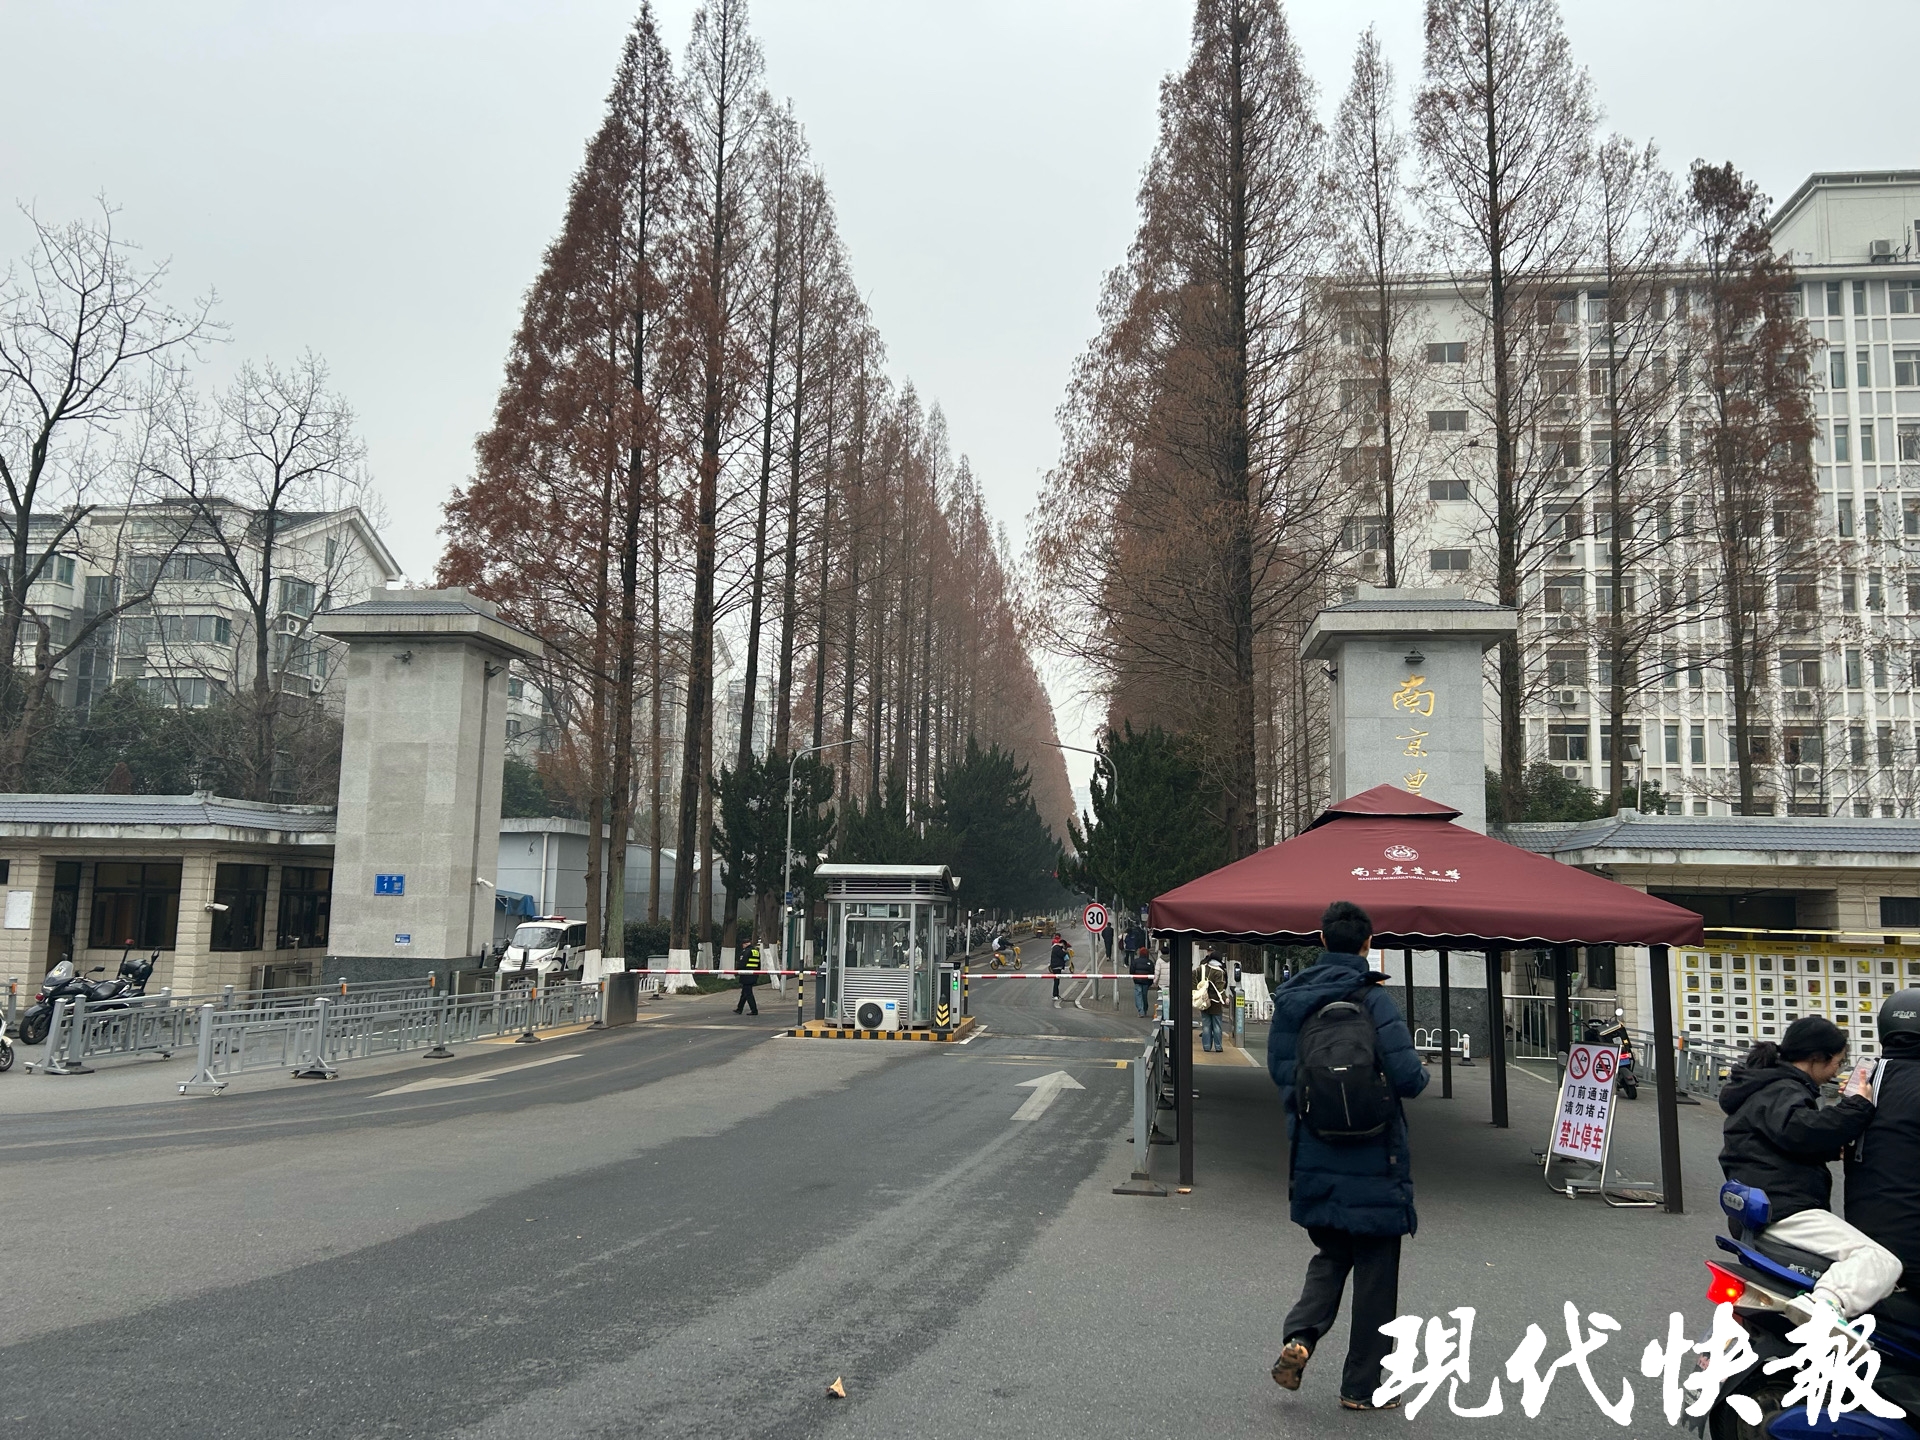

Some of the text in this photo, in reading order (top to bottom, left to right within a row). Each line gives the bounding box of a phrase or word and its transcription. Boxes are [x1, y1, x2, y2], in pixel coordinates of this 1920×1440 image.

[1087, 911, 1104, 926] 30
[1566, 1084, 1609, 1103] 门前通道
[1564, 1100, 1607, 1120] 请勿堵占
[1558, 1119, 1604, 1155] 禁止停车
